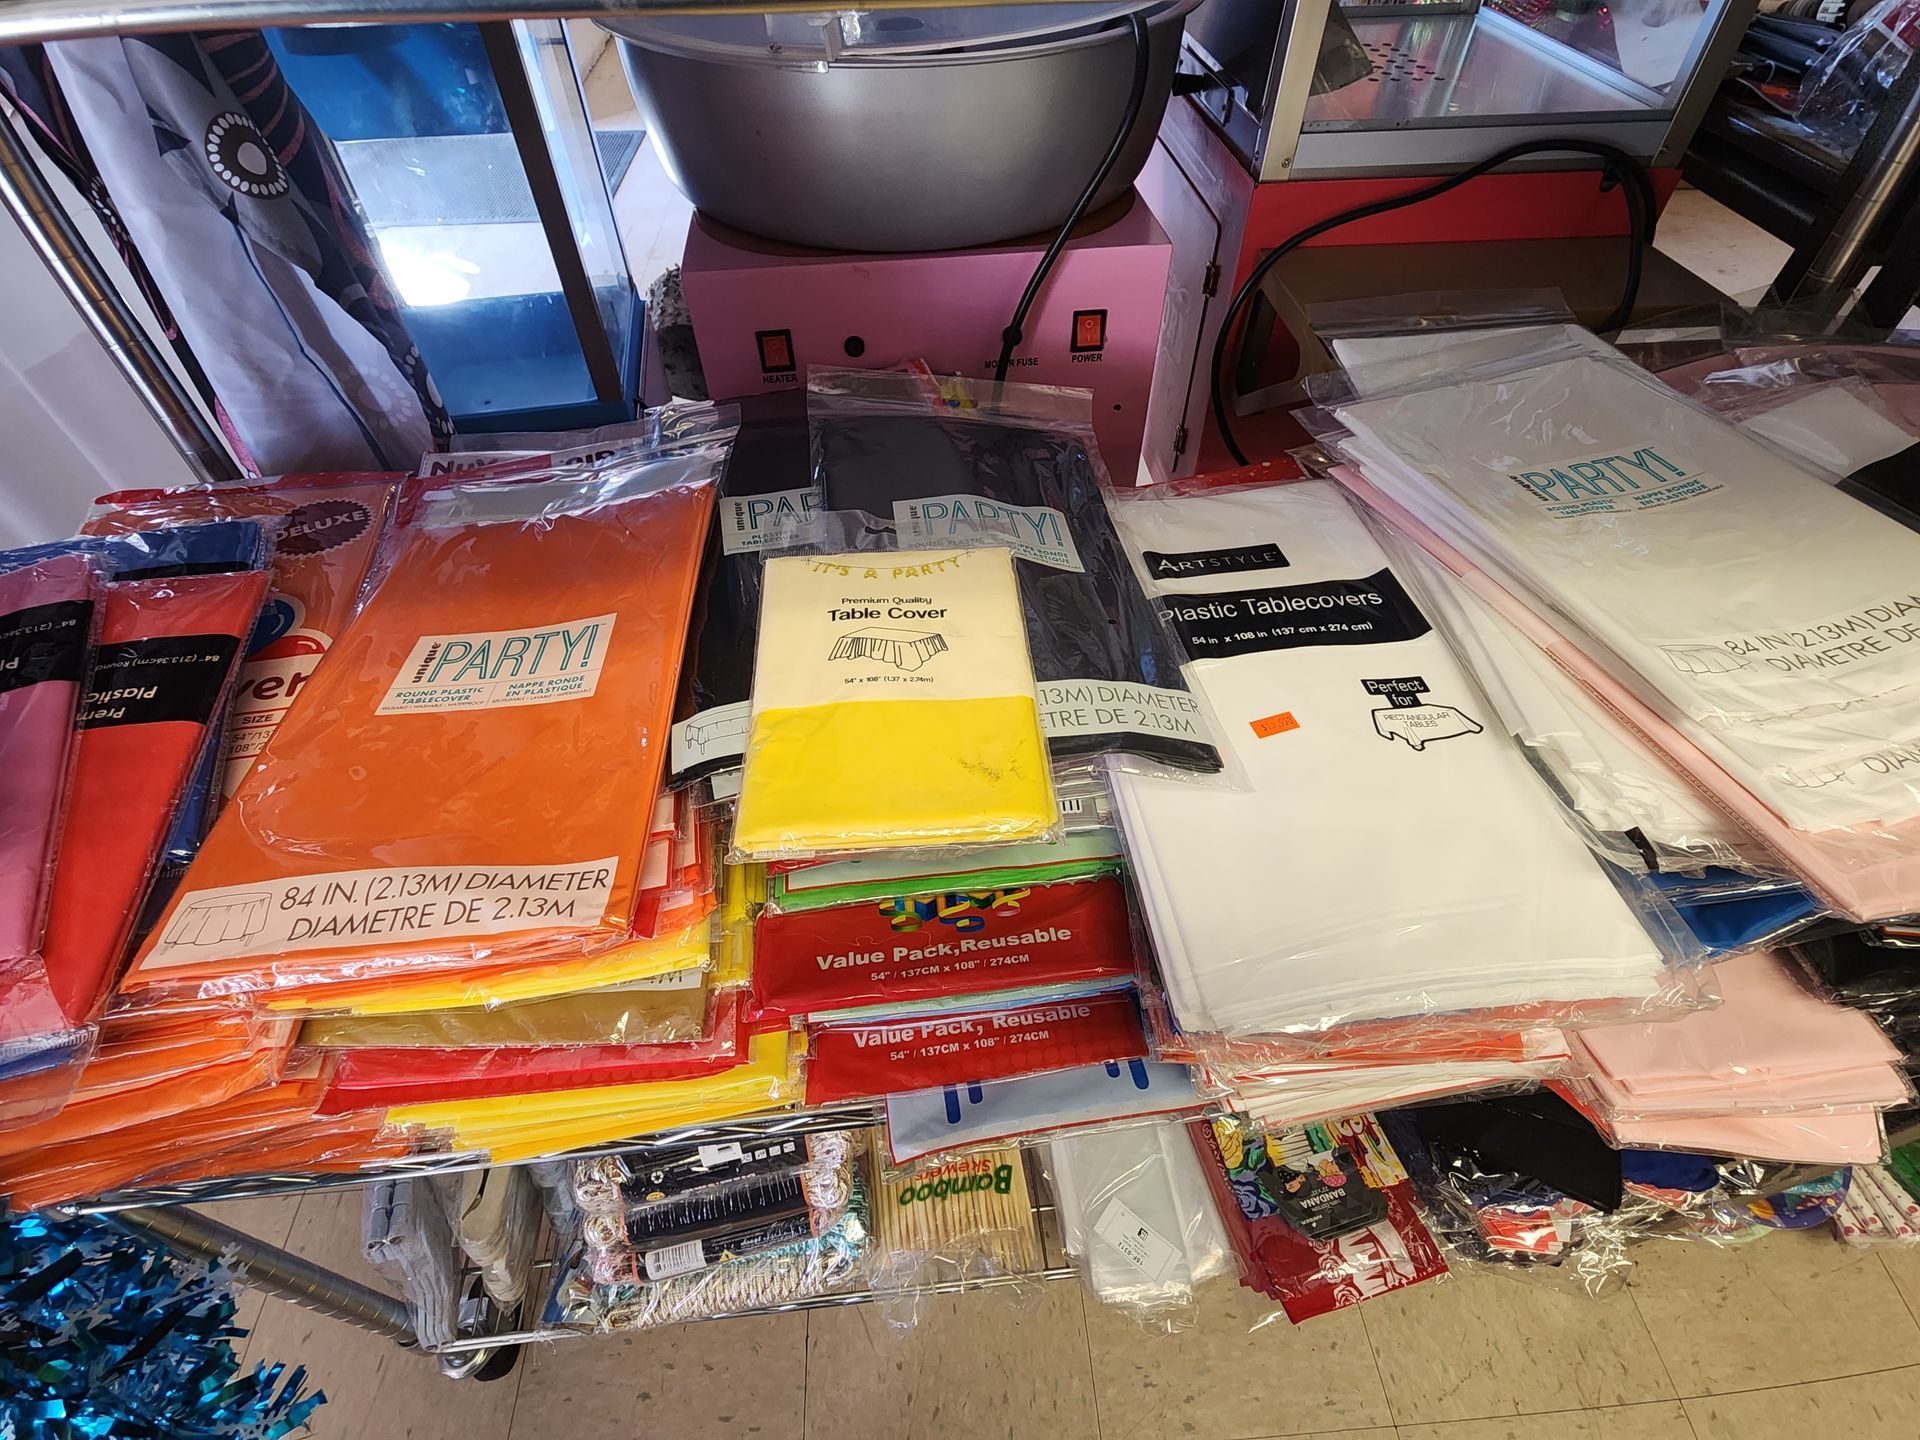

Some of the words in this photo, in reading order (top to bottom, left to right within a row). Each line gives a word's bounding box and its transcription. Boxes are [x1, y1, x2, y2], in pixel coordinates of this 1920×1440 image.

[984, 358, 1015, 370] MOR
[1016, 356, 1040, 367] FUSE
[1071, 352, 1103, 363] POWER
[762, 373, 798, 385] HEATER
[1520, 446, 1687, 502] PARTY!
[275, 509, 367, 542] DELUXE
[922, 499, 1065, 548] PARTY!
[811, 561, 850, 577] IT'S
[862, 567, 879, 580] A
[892, 556, 962, 579] PARTY
[841, 596, 889, 605] Premium
[892, 595, 932, 606] Quality
[1158, 601, 1239, 626] Plastic
[1239, 589, 1384, 618] Tablecovers
[54, 619, 77, 629] 84"
[827, 606, 881, 623] Table
[887, 606, 948, 620] Cover
[1191, 635, 1206, 646] 54
[1207, 635, 1219, 645] in
[1223, 635, 1233, 643] x
[1233, 630, 1256, 642] 108
[1256, 629, 1269, 639] in
[1271, 626, 1296, 639] (137
[1299, 625, 1318, 634] cm
[1319, 624, 1328, 633] x
[1328, 622, 1350, 634] 274
[1351, 620, 1374, 632] cm)
[427, 623, 601, 684] PARTY!
[1723, 639, 1761, 657] 84
[1765, 635, 1892, 673] DIAMETRE
[95, 659, 132, 672] Round
[131, 653, 197, 668] (213.36cm)
[198, 653, 221, 664] 84"
[411, 641, 442, 684] unique
[395, 689, 438, 699] ROUND
[439, 686, 485, 696] PLASTIC
[505, 689, 523, 698] EN
[524, 681, 585, 696] PLASTIQUE
[508, 680, 546, 690] NAPPE
[547, 675, 586, 686] RONDE
[1366, 679, 1425, 695] Perfect
[401, 694, 471, 705] TABLECOVER
[1097, 686, 1201, 716] DIAMETER
[1391, 693, 1414, 708] for
[241, 713, 275, 725] SIZE
[1095, 708, 1127, 727] DE
[1133, 709, 1198, 736] 2.13M
[1383, 710, 1451, 722] RECTANGULAR
[1403, 719, 1439, 729] TABLES
[279, 886, 313, 912] 84
[321, 881, 358, 907] IN.
[364, 872, 462, 907] (2.13M)
[466, 867, 610, 892] DIAMETER
[287, 905, 434, 942] DIAMETRE
[444, 900, 483, 925] DE
[491, 896, 578, 921] 2.13M
[815, 947, 886, 972] Value
[870, 970, 891, 982] 54"
[900, 965, 941, 979] 137CM
[942, 965, 951, 973] x
[953, 958, 981, 972] 108"
[989, 953, 1030, 968] 274CM
[853, 1025, 916, 1050] Value
[920, 1019, 984, 1041] Pack,
[991, 1003, 1092, 1029] Reusable
[890, 1050, 911, 1062] 54"
[919, 1043, 961, 1057] 137CM
[962, 1042, 971, 1051] x
[972, 1035, 1001, 1050] 108"
[1009, 1029, 1050, 1045] 274CM
[899, 1163, 1013, 1206] Bamboo
[1299, 1187, 1347, 1209] BANDANA
